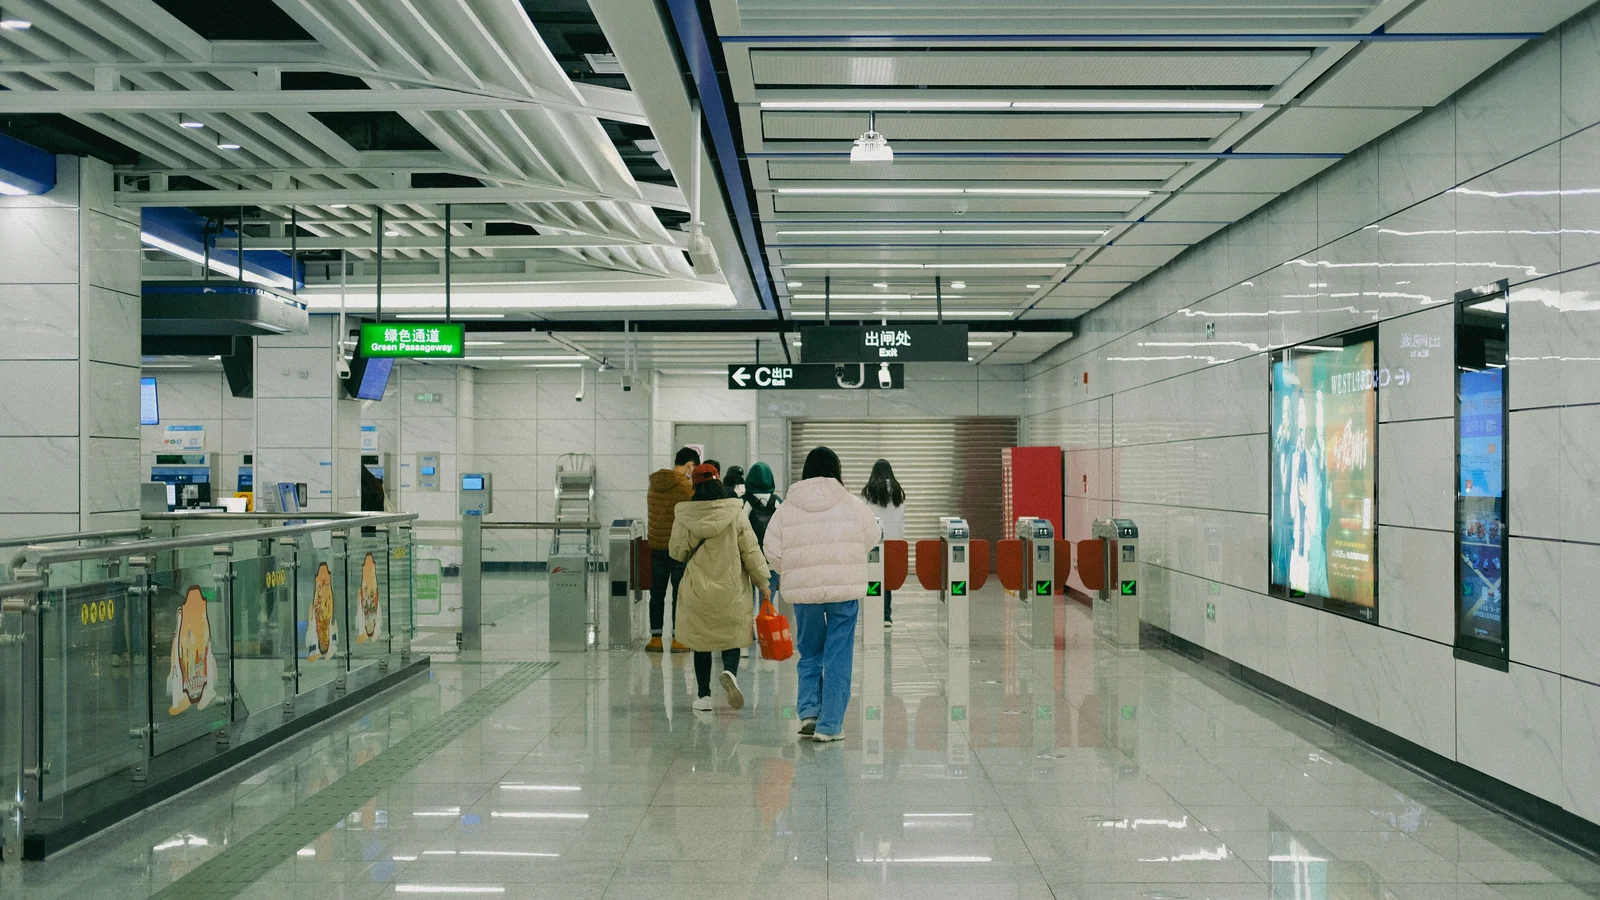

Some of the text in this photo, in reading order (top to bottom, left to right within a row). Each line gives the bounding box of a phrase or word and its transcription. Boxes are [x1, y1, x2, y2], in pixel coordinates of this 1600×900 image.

[384, 328, 440, 343] 绿色通道
[865, 330, 911, 347] 出闸处
[371, 343, 452, 353] Green Passageway
[879, 347, 898, 357] Exit
[755, 367, 793, 386] C 出口
